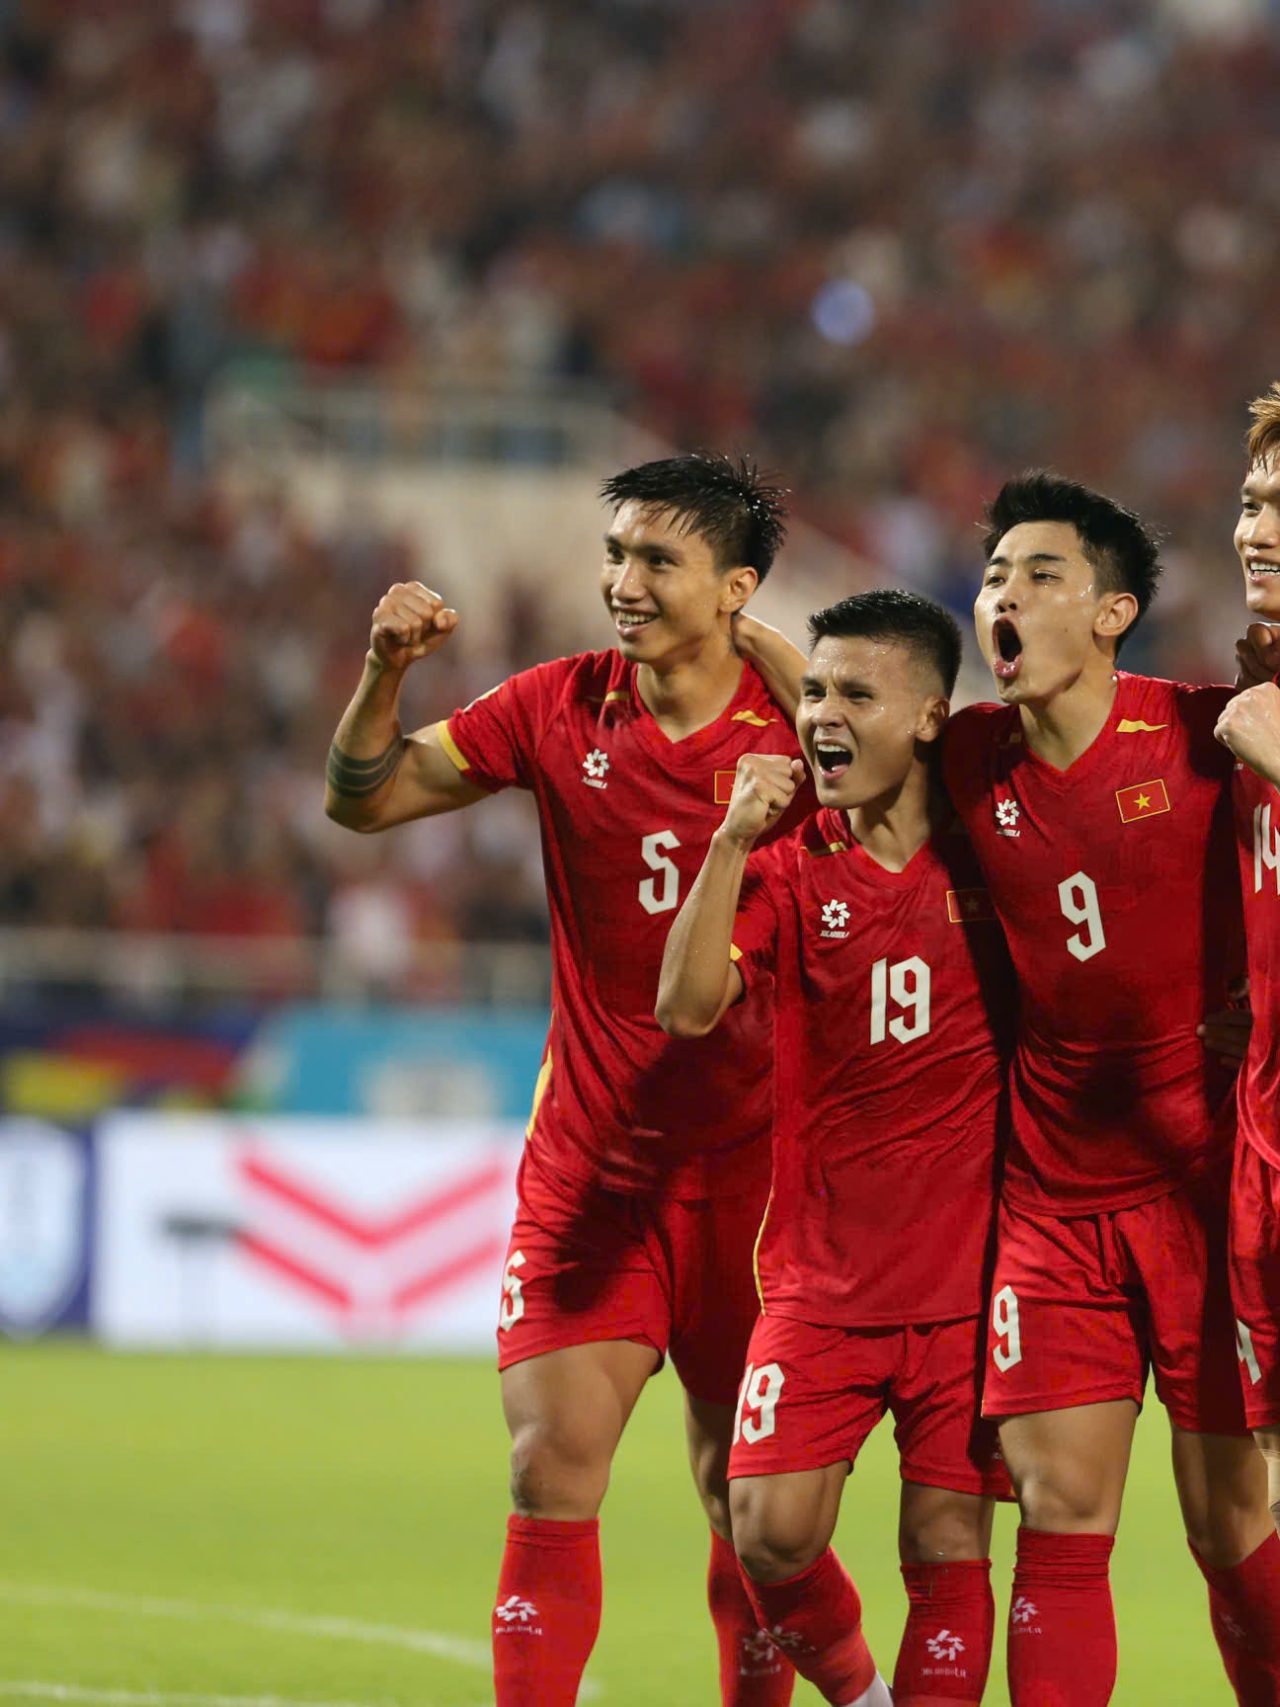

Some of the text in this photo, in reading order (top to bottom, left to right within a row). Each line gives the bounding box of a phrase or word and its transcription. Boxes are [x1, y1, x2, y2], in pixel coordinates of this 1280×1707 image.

[638, 829, 682, 916] 5
[1057, 870, 1107, 963] 9
[869, 955, 931, 1046] 19
[992, 1284, 1023, 1374] 9
[732, 1361, 786, 1448] 19
